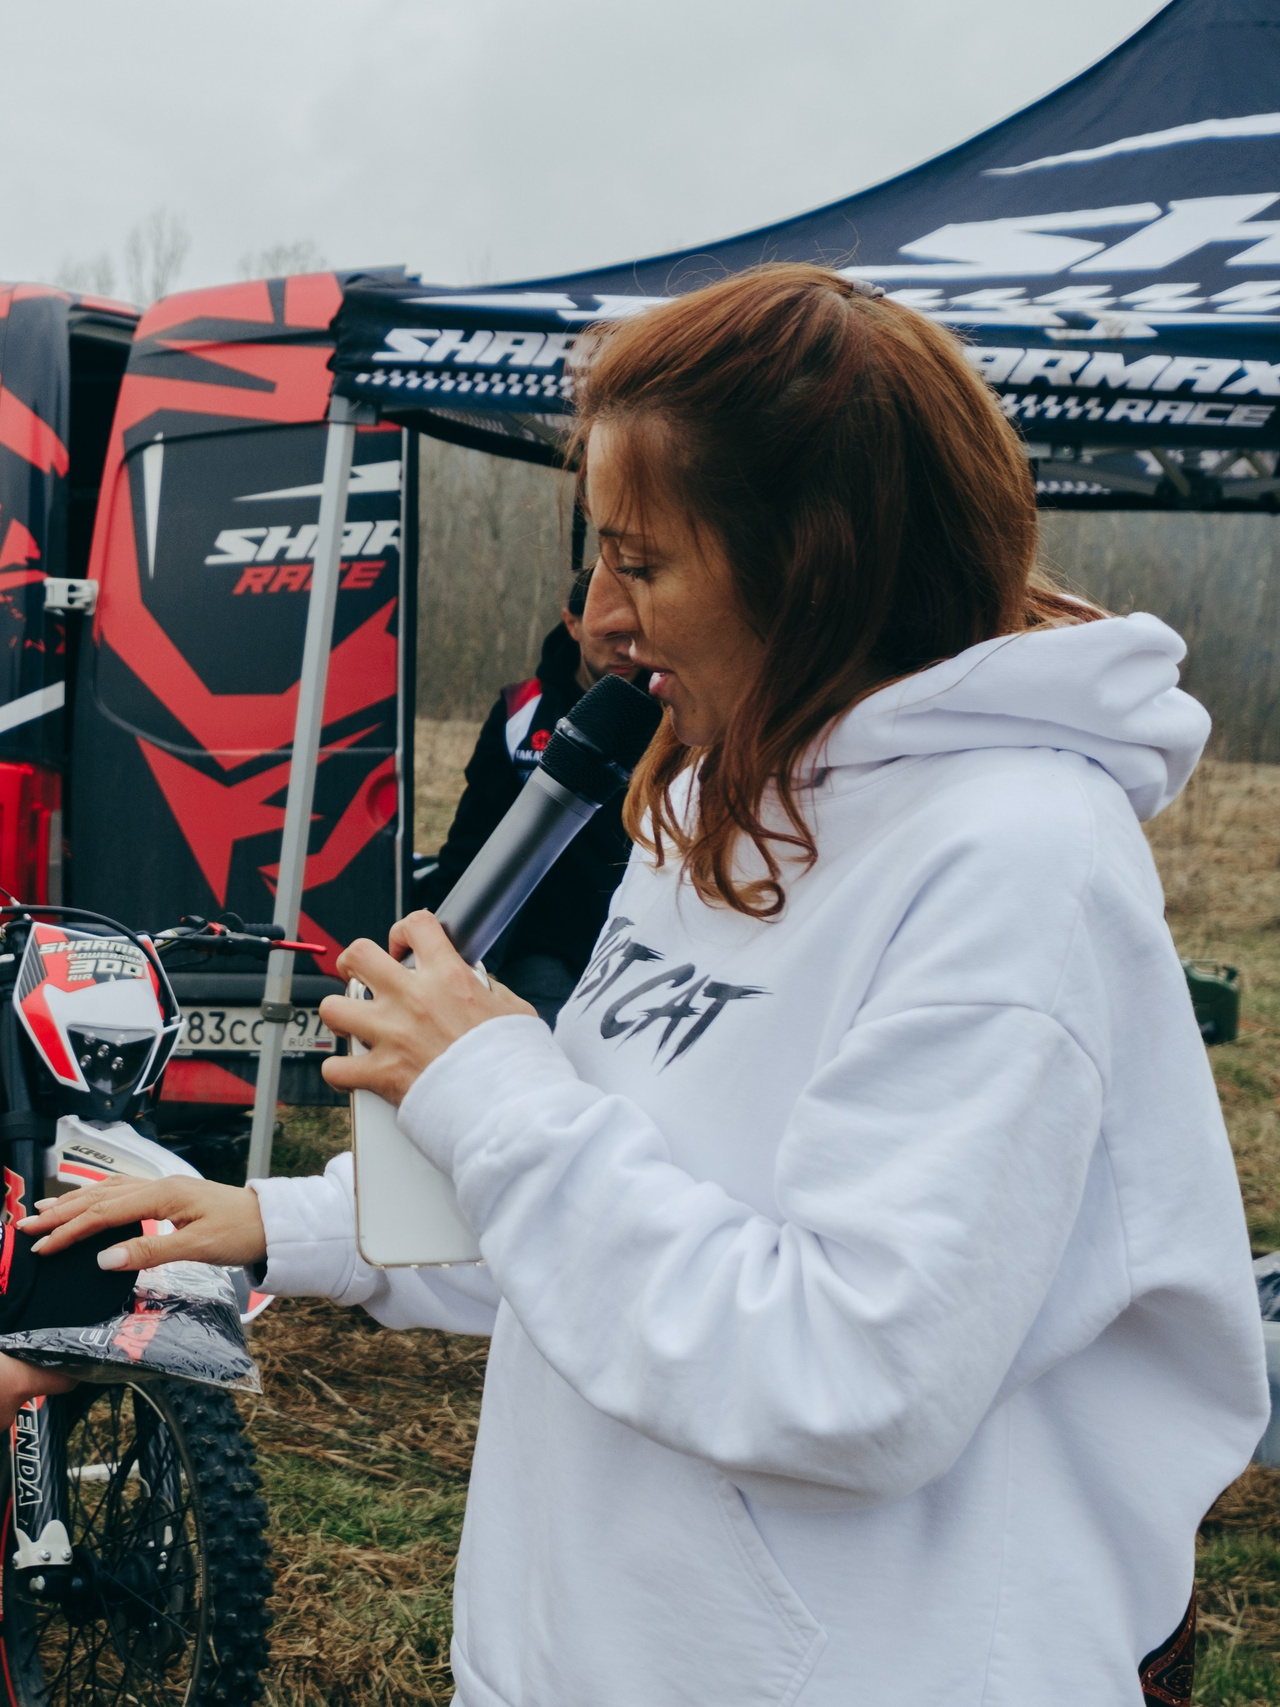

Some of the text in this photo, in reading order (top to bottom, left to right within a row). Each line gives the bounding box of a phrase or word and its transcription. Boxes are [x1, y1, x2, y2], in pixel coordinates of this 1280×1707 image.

[1105, 398, 1276, 428] RACE
[39, 939, 142, 957] SHARMA
[67, 959, 144, 978] 300
[67, 973, 94, 982] AIR
[178, 1010, 265, 1046] 83CC
[599, 962, 774, 1076] CAT
[289, 1037, 314, 1047] RUS
